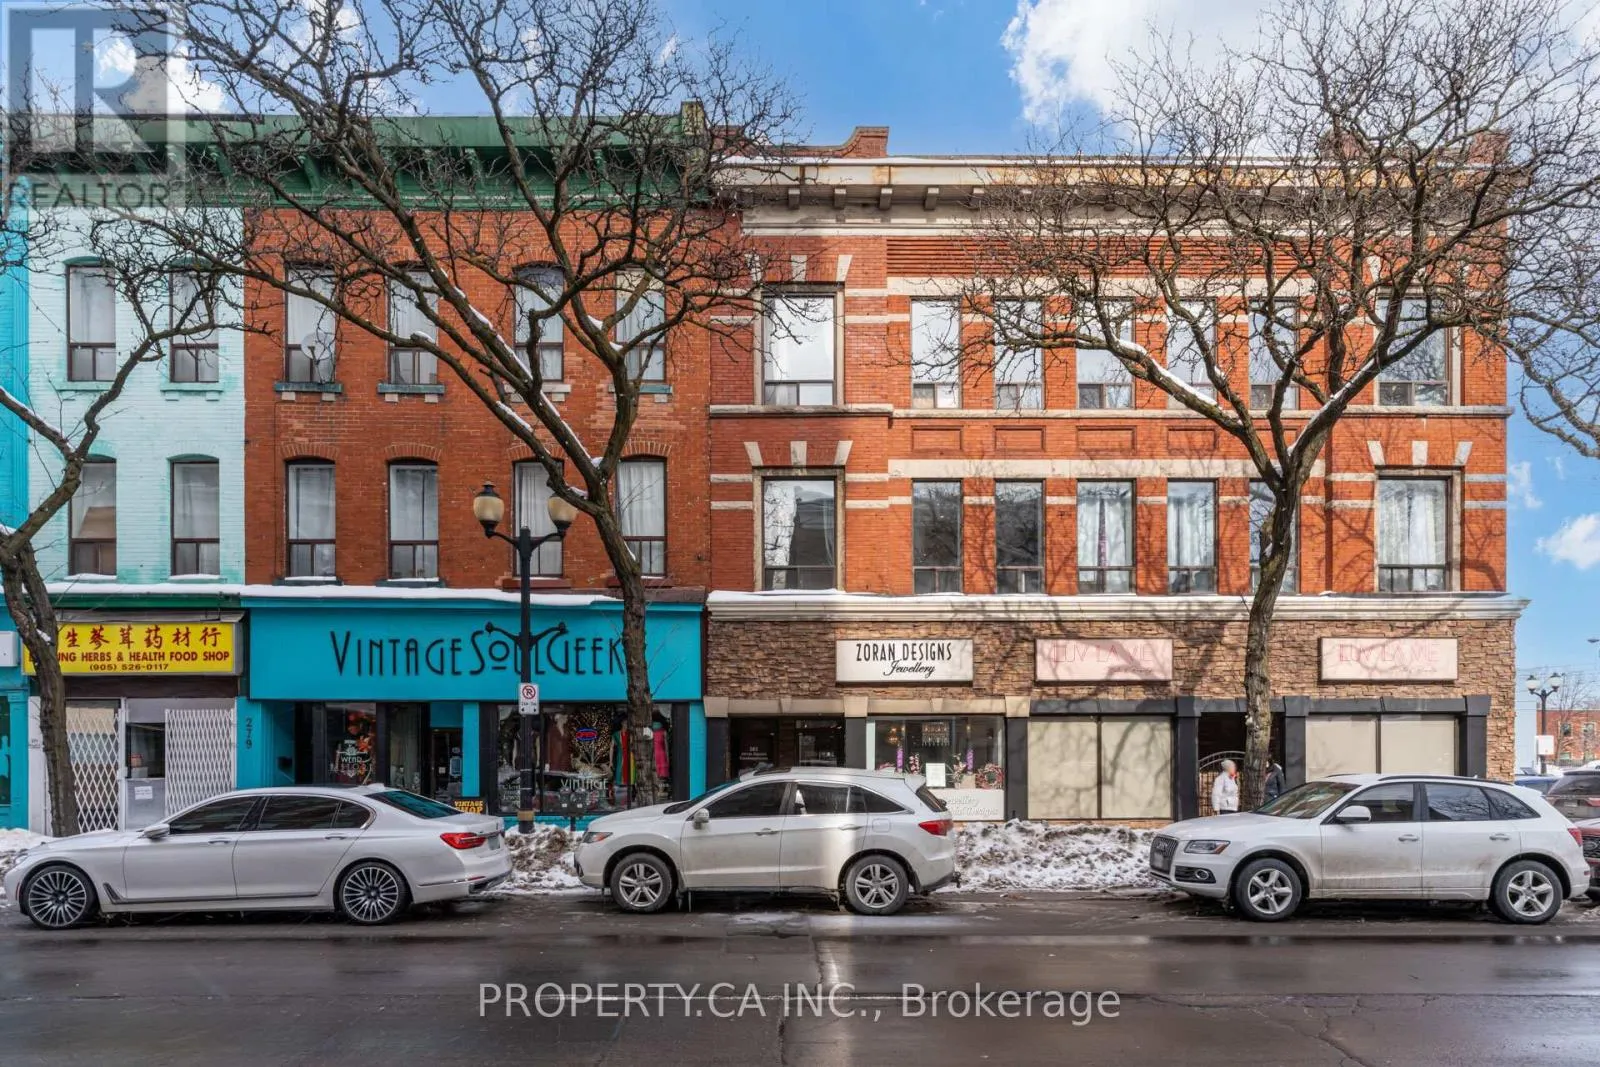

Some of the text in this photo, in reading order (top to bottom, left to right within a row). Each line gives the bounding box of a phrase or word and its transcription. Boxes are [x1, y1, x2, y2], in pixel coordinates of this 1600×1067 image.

[57, 651, 230, 662] UNG HERBS & HEALTH FOOD SHOP
[856, 642, 952, 661] ZORAN DESIGNS
[89, 663, 169, 671] (905) 526-0117
[883, 659, 935, 679] Jewellery
